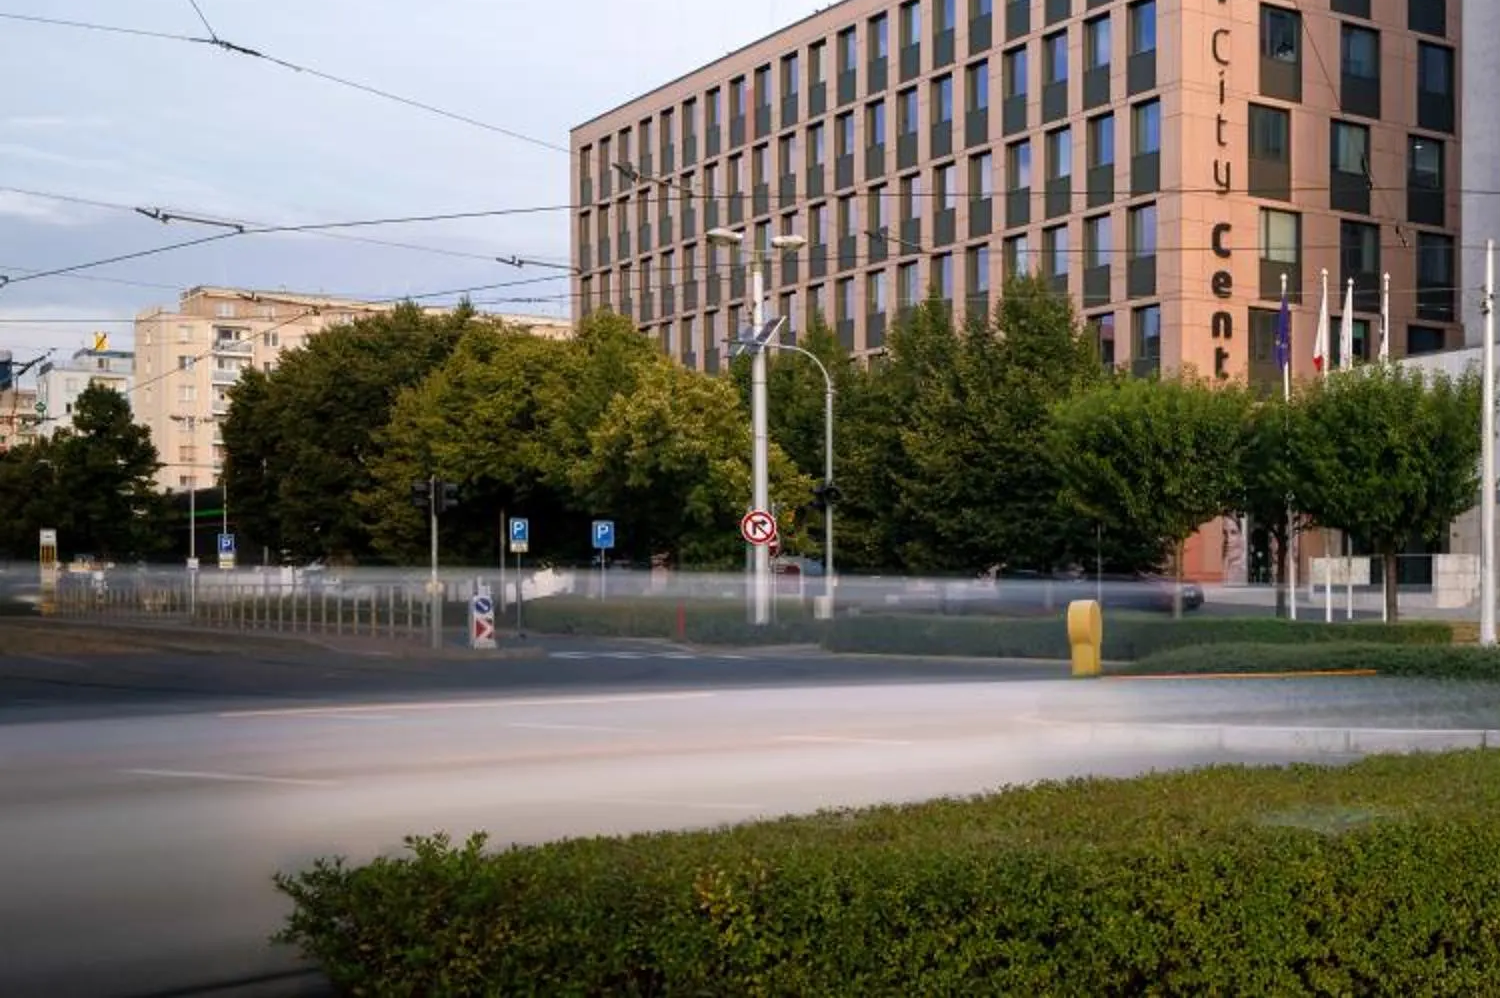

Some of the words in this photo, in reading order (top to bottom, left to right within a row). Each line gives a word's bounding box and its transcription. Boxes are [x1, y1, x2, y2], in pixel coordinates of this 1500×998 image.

[1211, 28, 1232, 196] City
[513, 521, 525, 536] P
[597, 524, 609, 539] P
